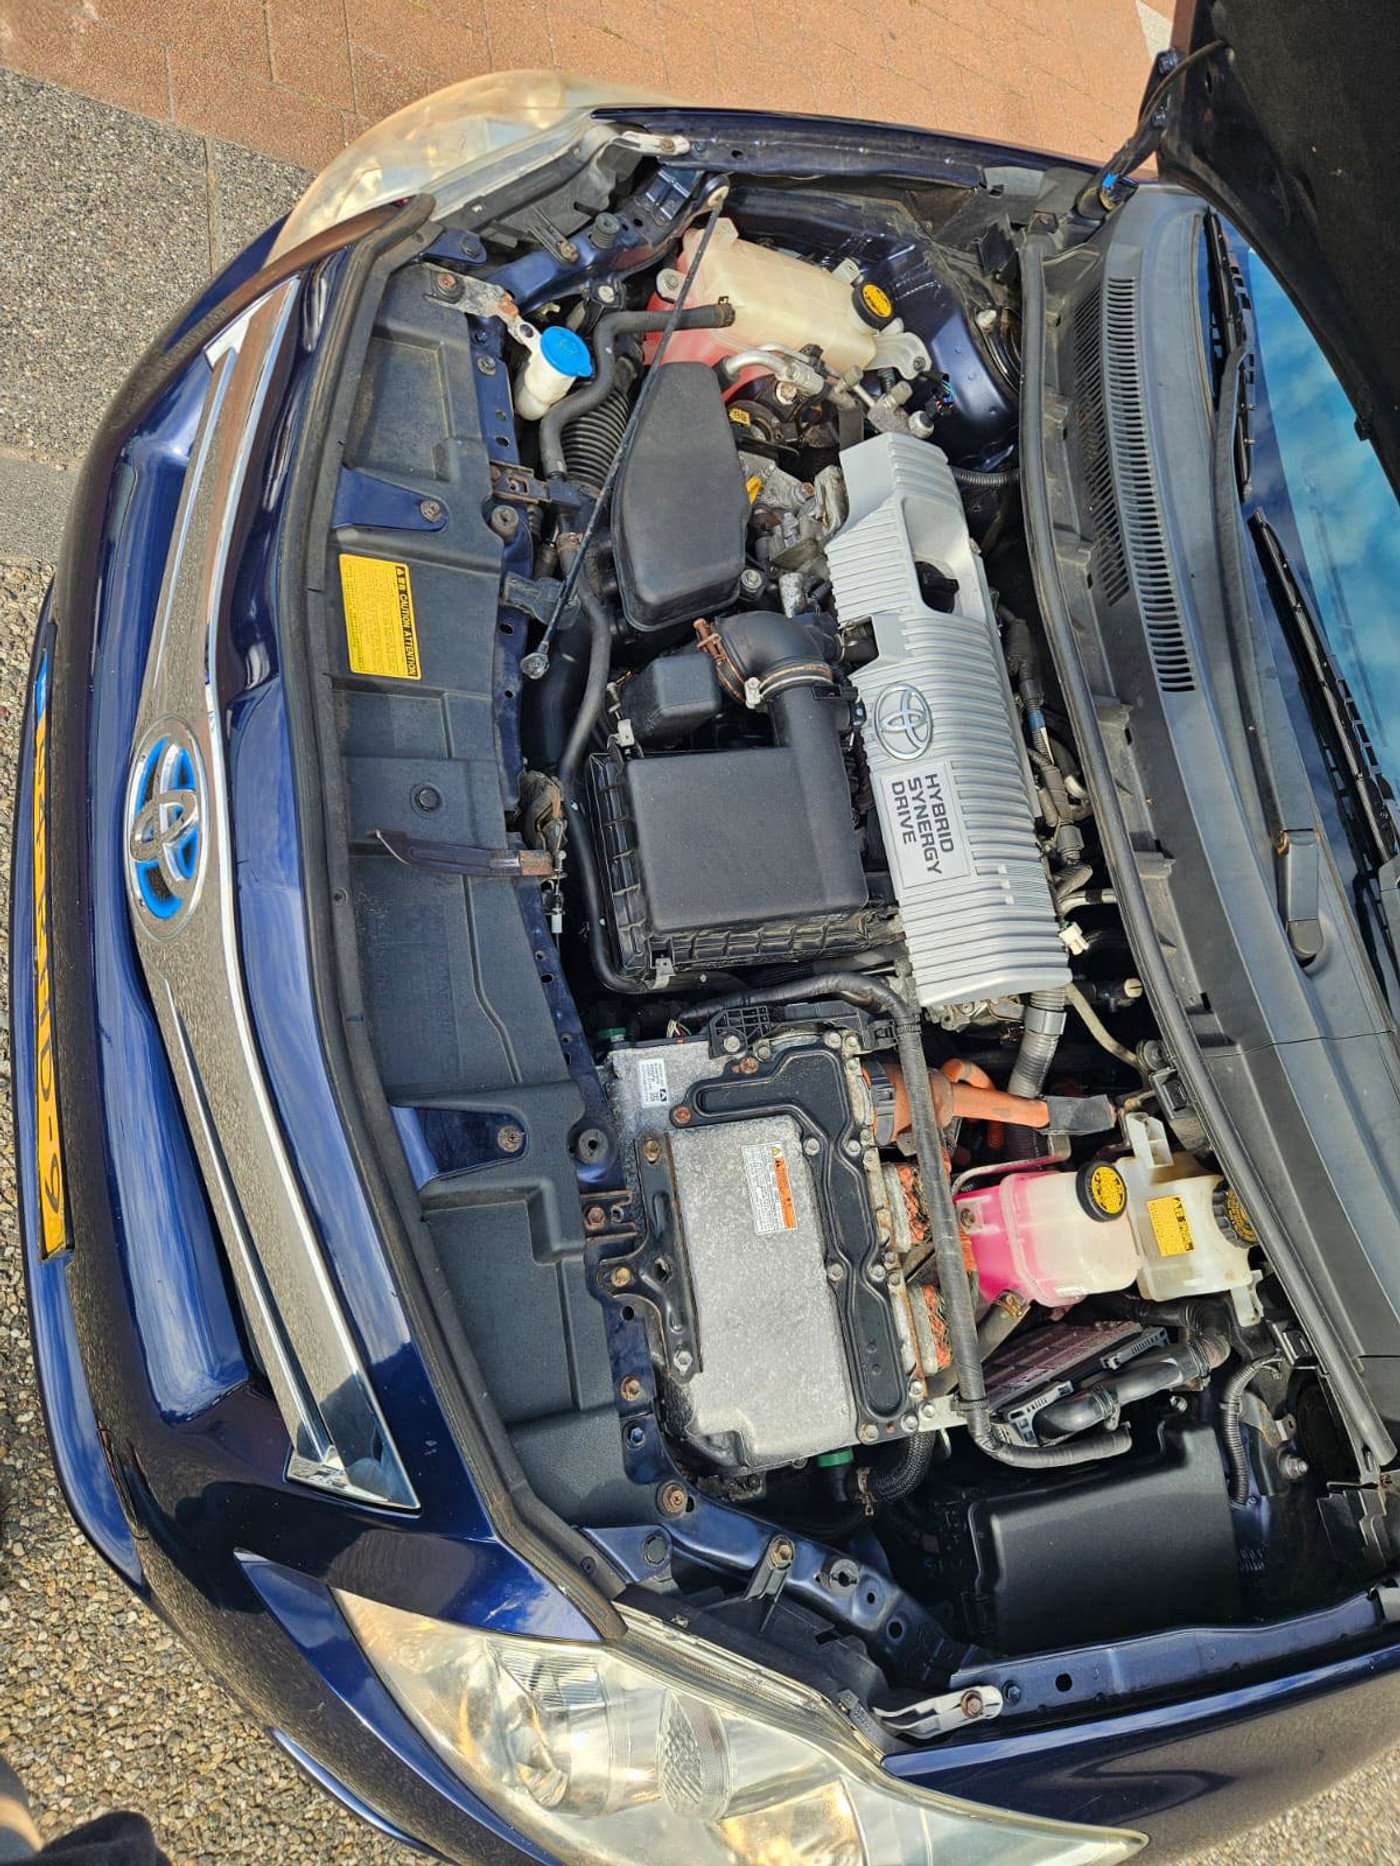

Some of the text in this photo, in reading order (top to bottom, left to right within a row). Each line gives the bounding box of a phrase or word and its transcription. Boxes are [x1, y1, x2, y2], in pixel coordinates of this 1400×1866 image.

[400, 594, 411, 627] CAUTION
[404, 632, 418, 676] ATTENTION
[892, 781, 917, 844] DRIVE
[907, 777, 942, 874] SYNERGY
[925, 773, 954, 853] HYBRID
